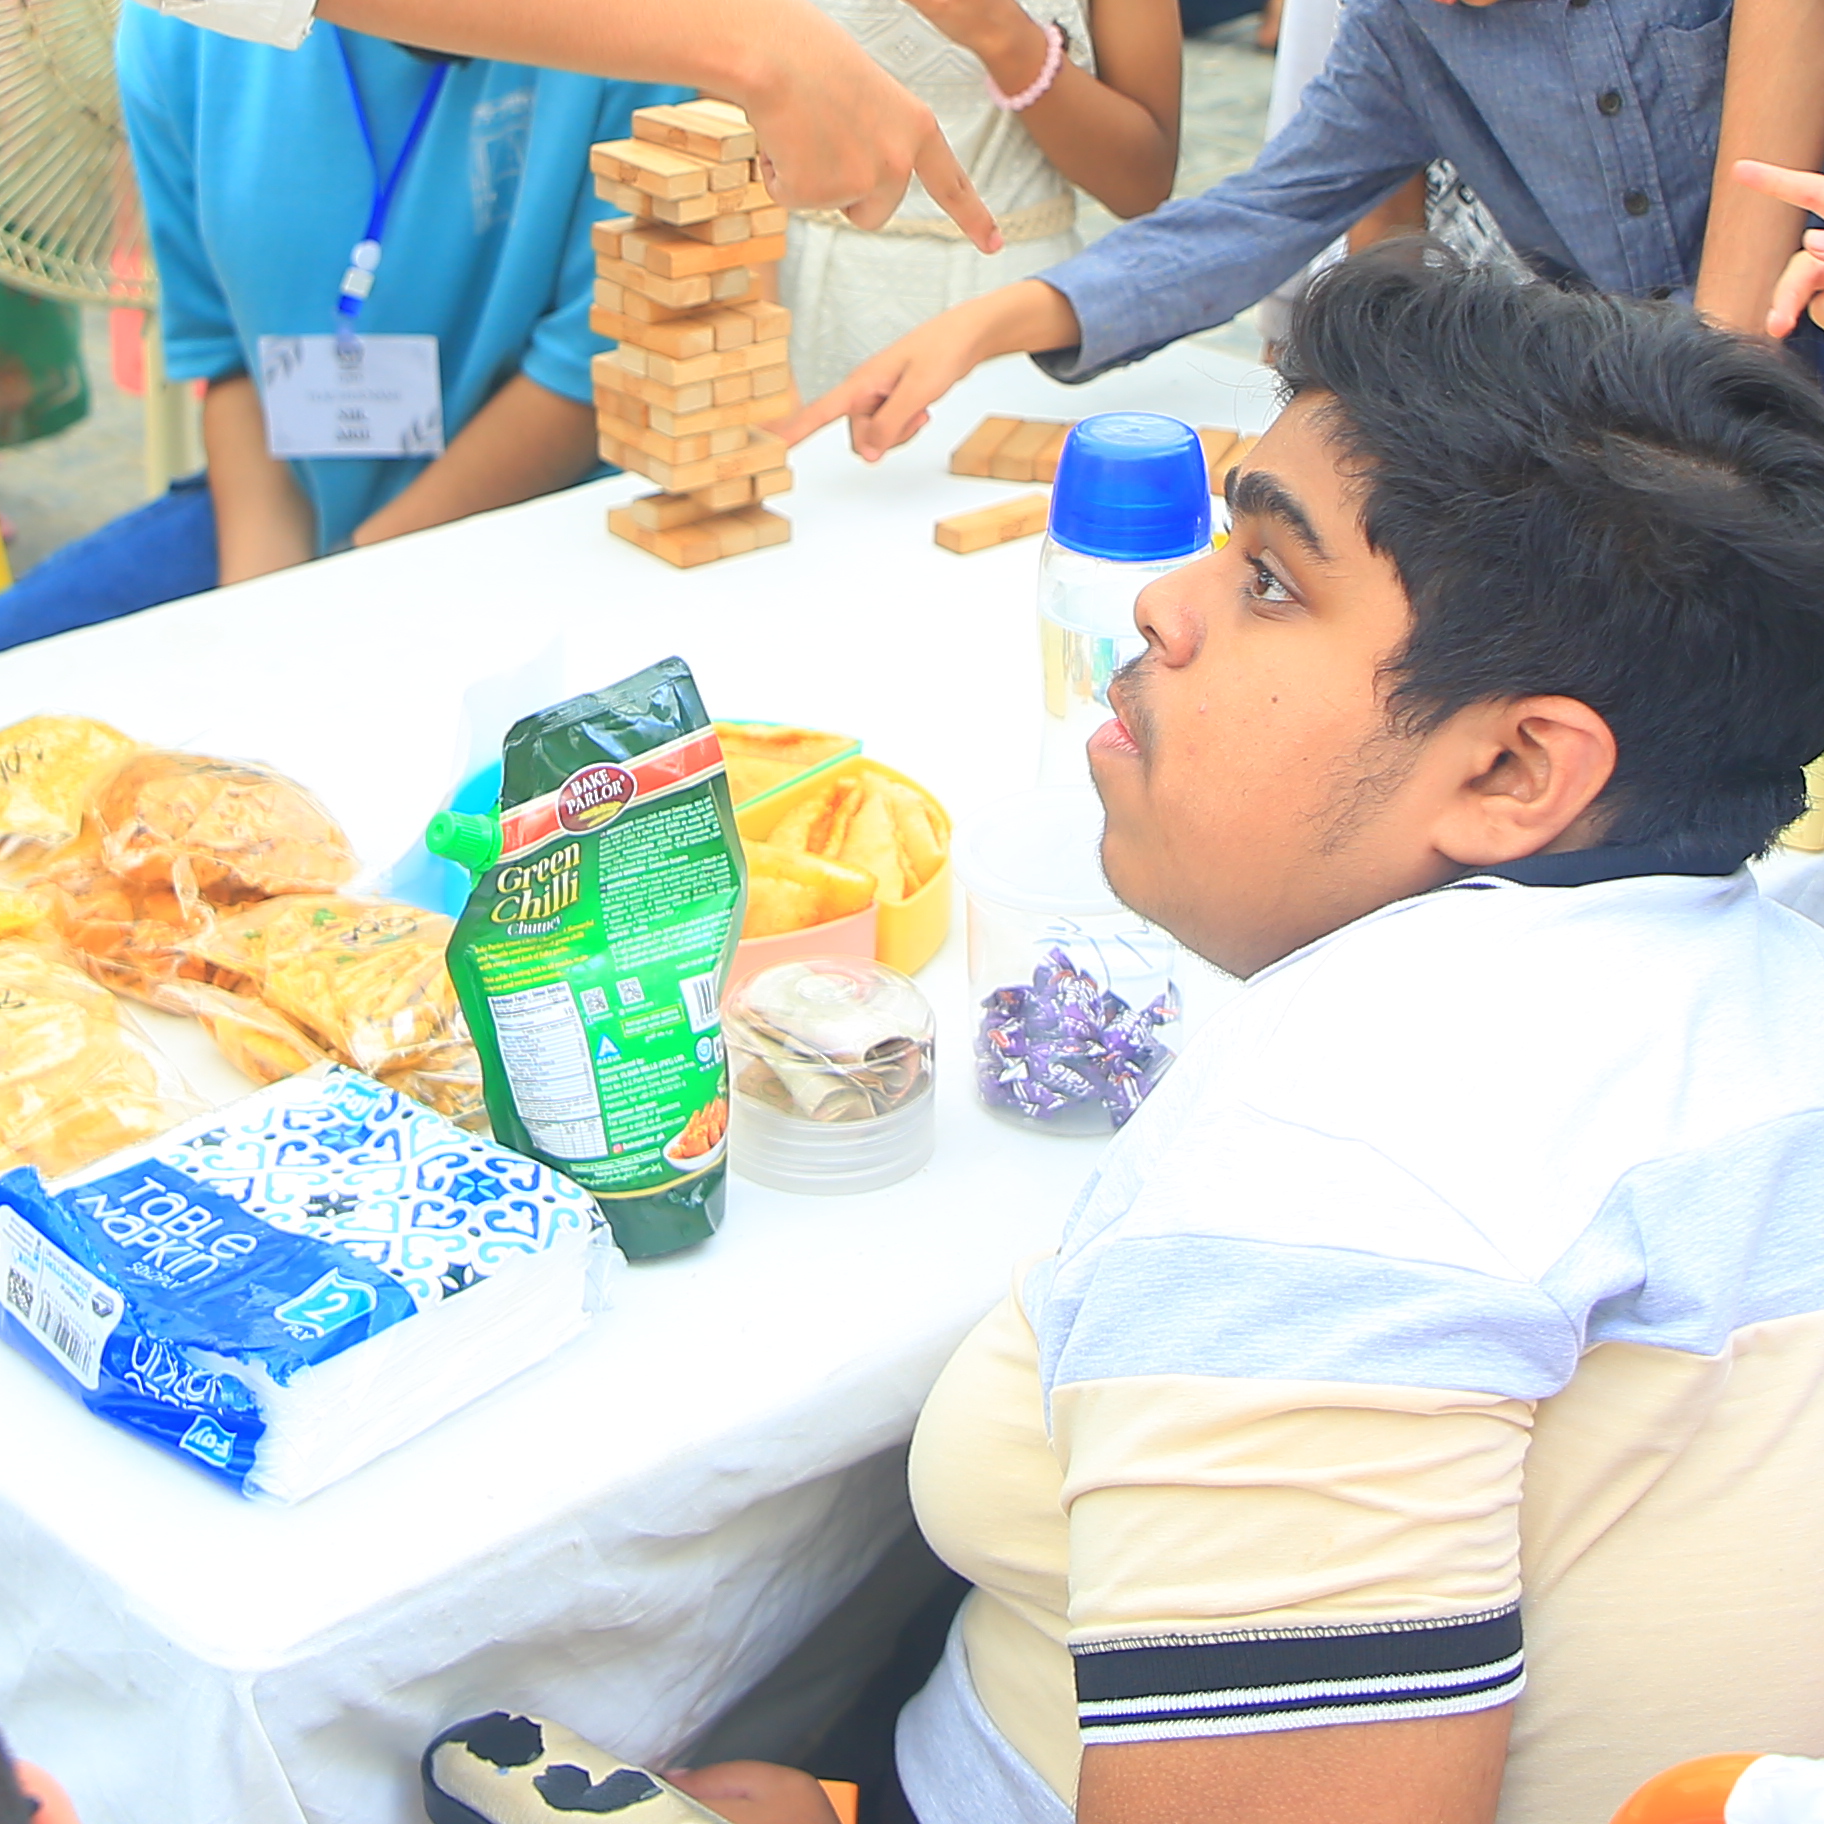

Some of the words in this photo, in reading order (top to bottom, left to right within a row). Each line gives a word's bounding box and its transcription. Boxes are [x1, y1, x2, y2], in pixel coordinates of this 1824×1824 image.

[565, 779, 624, 815] PARLOR
[570, 768, 611, 796] BAKE
[497, 842, 581, 894] Green
[490, 870, 580, 924] Chilli
[301, 1292, 349, 1321] 2
[282, 1323, 315, 1342] PLY
[188, 1426, 232, 1459] Fay
